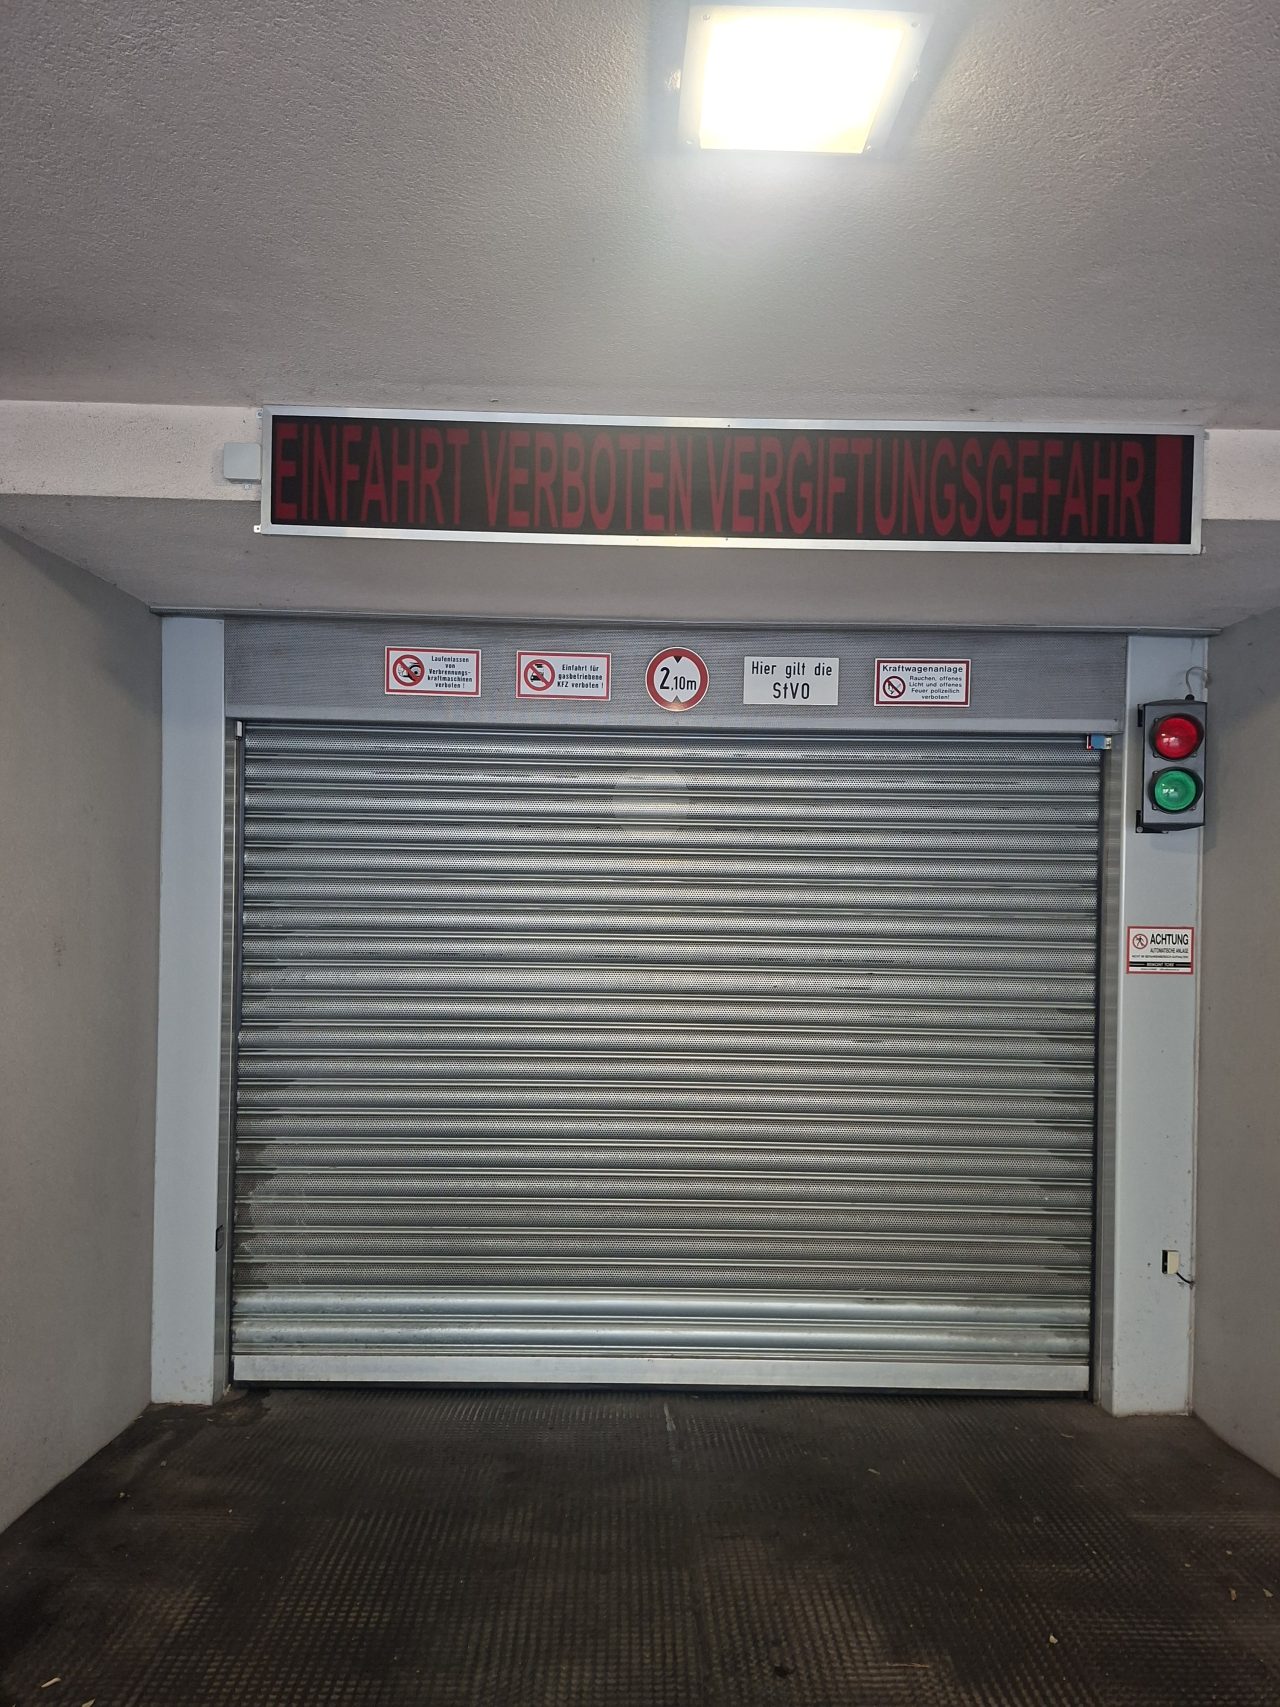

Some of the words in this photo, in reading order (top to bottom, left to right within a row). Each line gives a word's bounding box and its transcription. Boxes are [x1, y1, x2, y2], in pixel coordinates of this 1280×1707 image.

[274, 421, 470, 525] EINFAHRT
[481, 430, 694, 532] VERBOTEN
[706, 435, 1147, 538] VERGIFTUNGSGEFAHR
[429, 668, 471, 676] Verbrennungs-
[751, 661, 777, 675] Hier
[785, 662, 806, 679] gilt
[814, 662, 833, 677] die
[882, 664, 963, 674] Kraftwagenanlage
[558, 672, 603, 681] gasbetriebene
[772, 682, 810, 700] StVO
[1150, 933, 1189, 945] ACHTUNG
